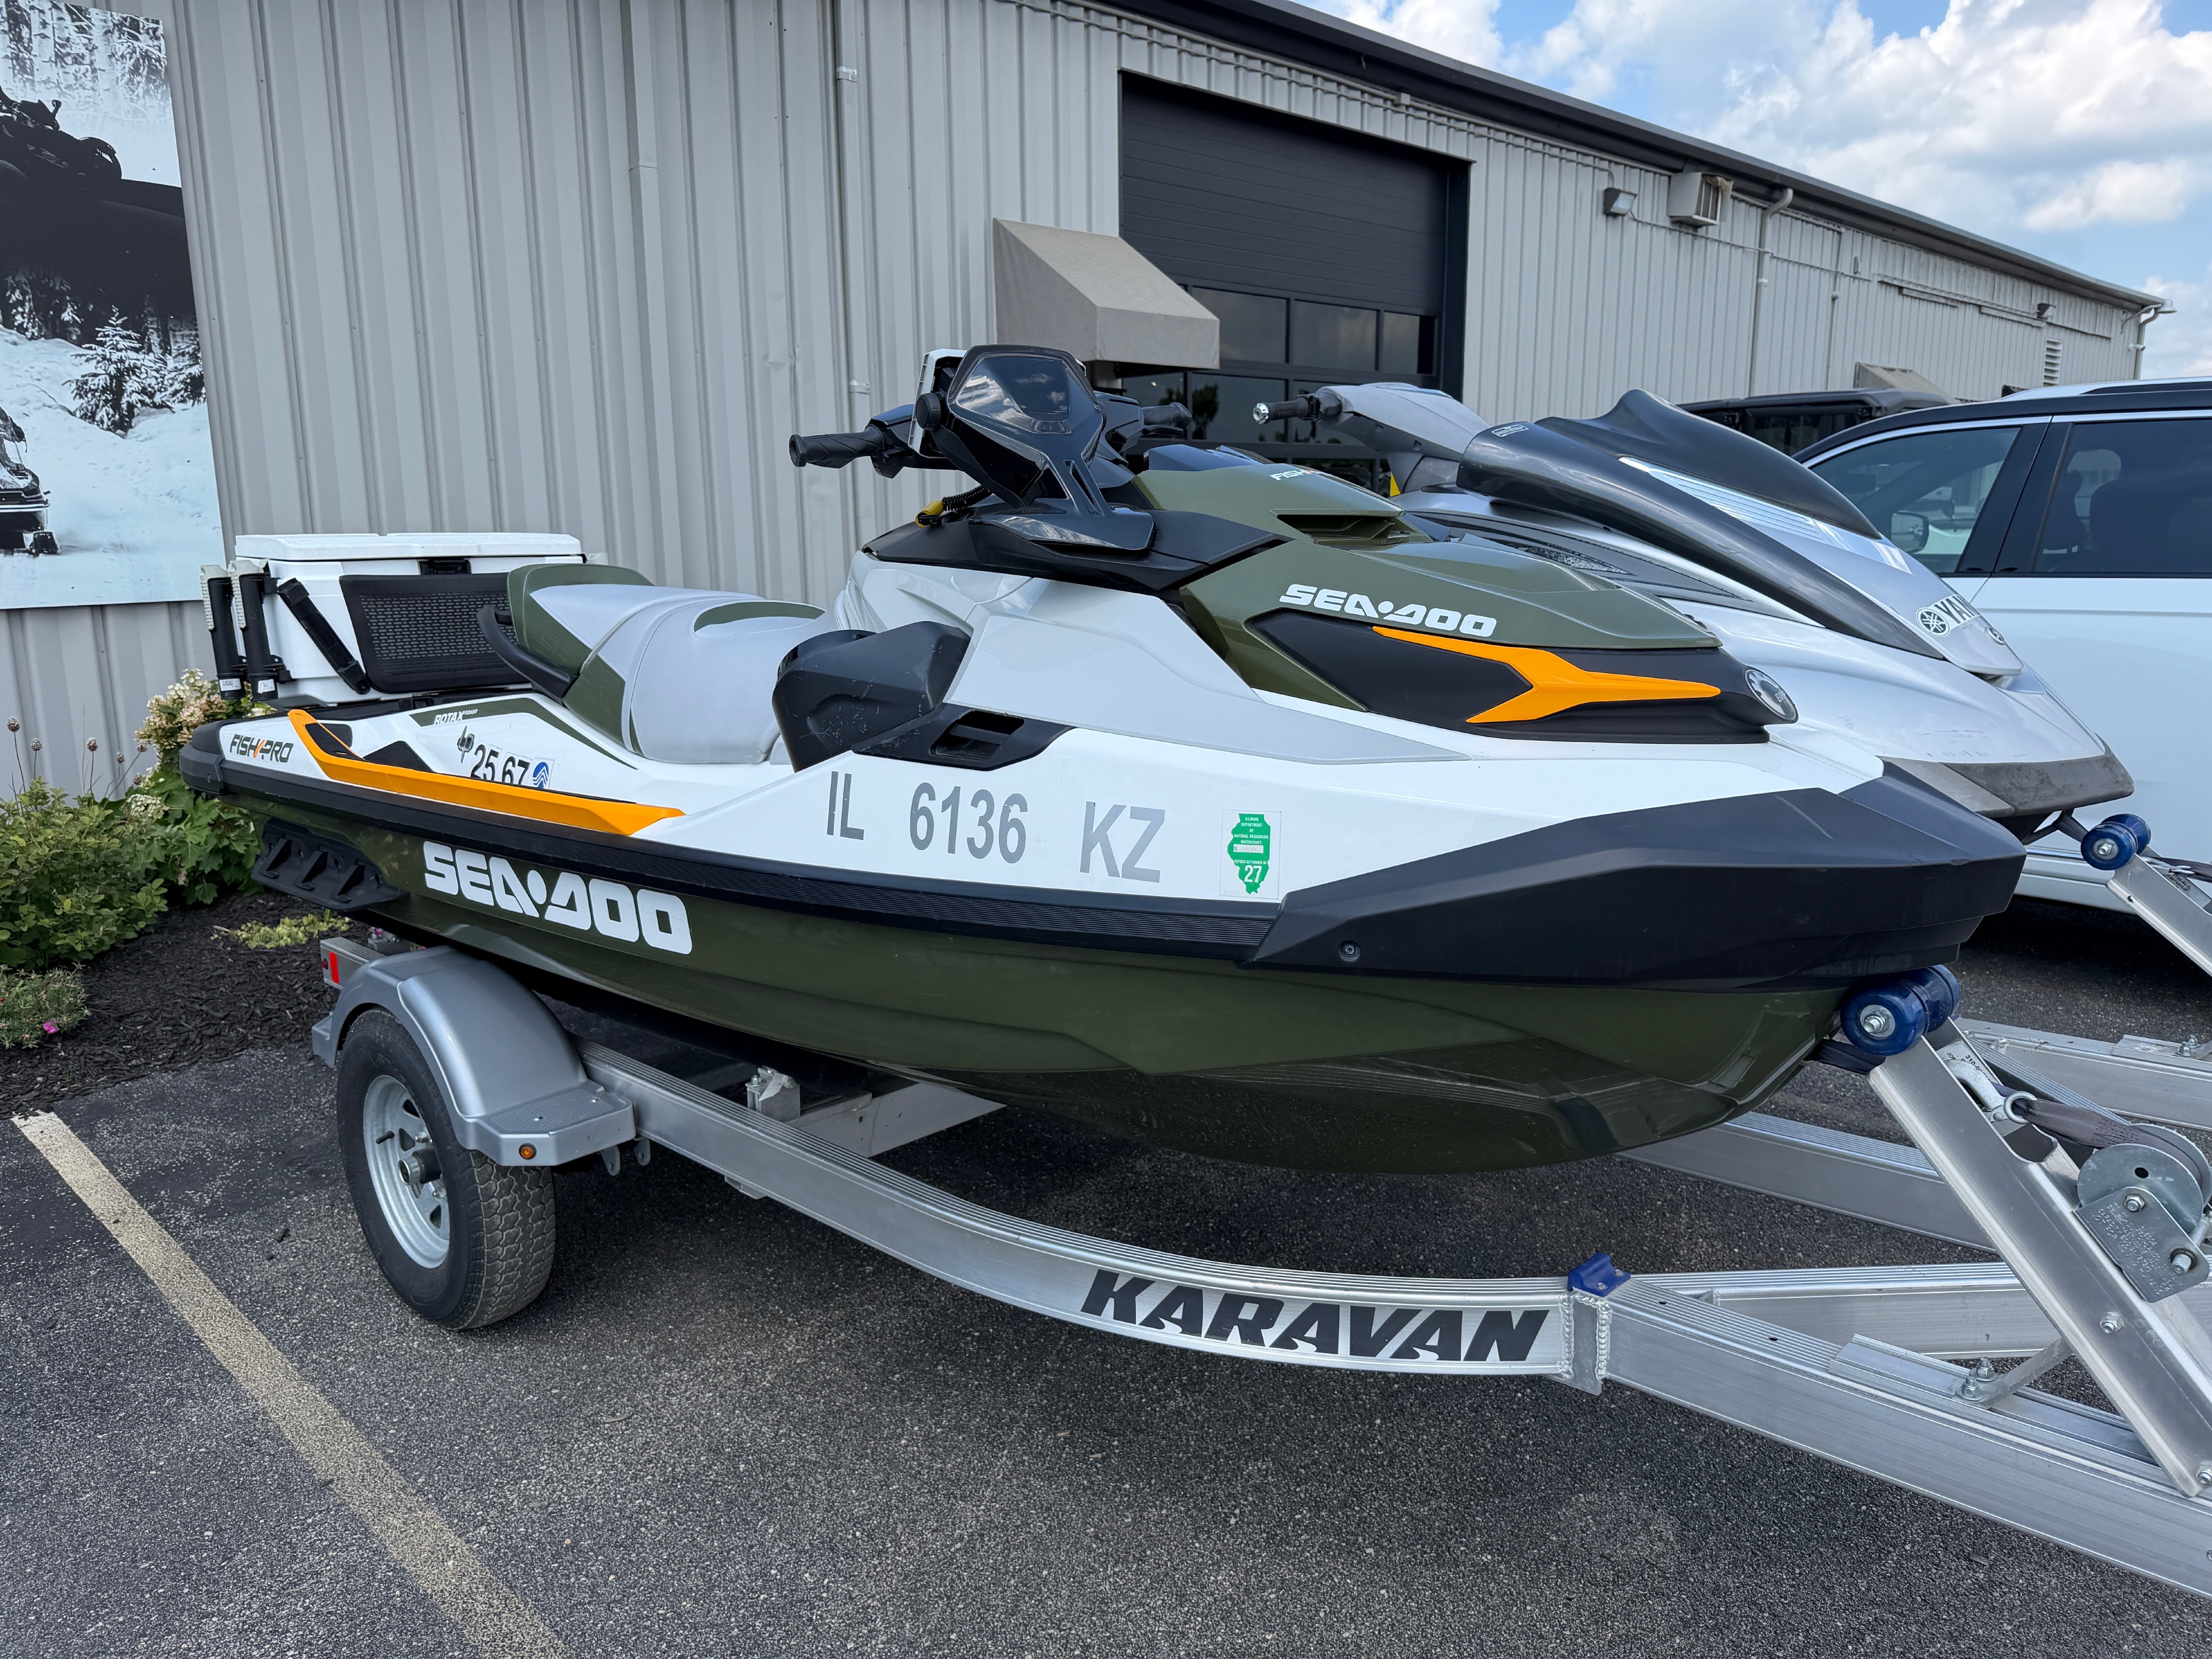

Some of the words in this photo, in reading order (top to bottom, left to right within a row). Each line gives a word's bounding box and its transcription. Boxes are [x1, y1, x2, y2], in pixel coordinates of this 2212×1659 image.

[434, 710, 464, 725] ROTAX
[827, 771, 864, 840] IL
[910, 782, 1028, 864] 6136
[1080, 801, 1166, 883] KZ
[1244, 865, 1262, 883] 27
[1080, 1269, 1550, 1361] KARAVAN
